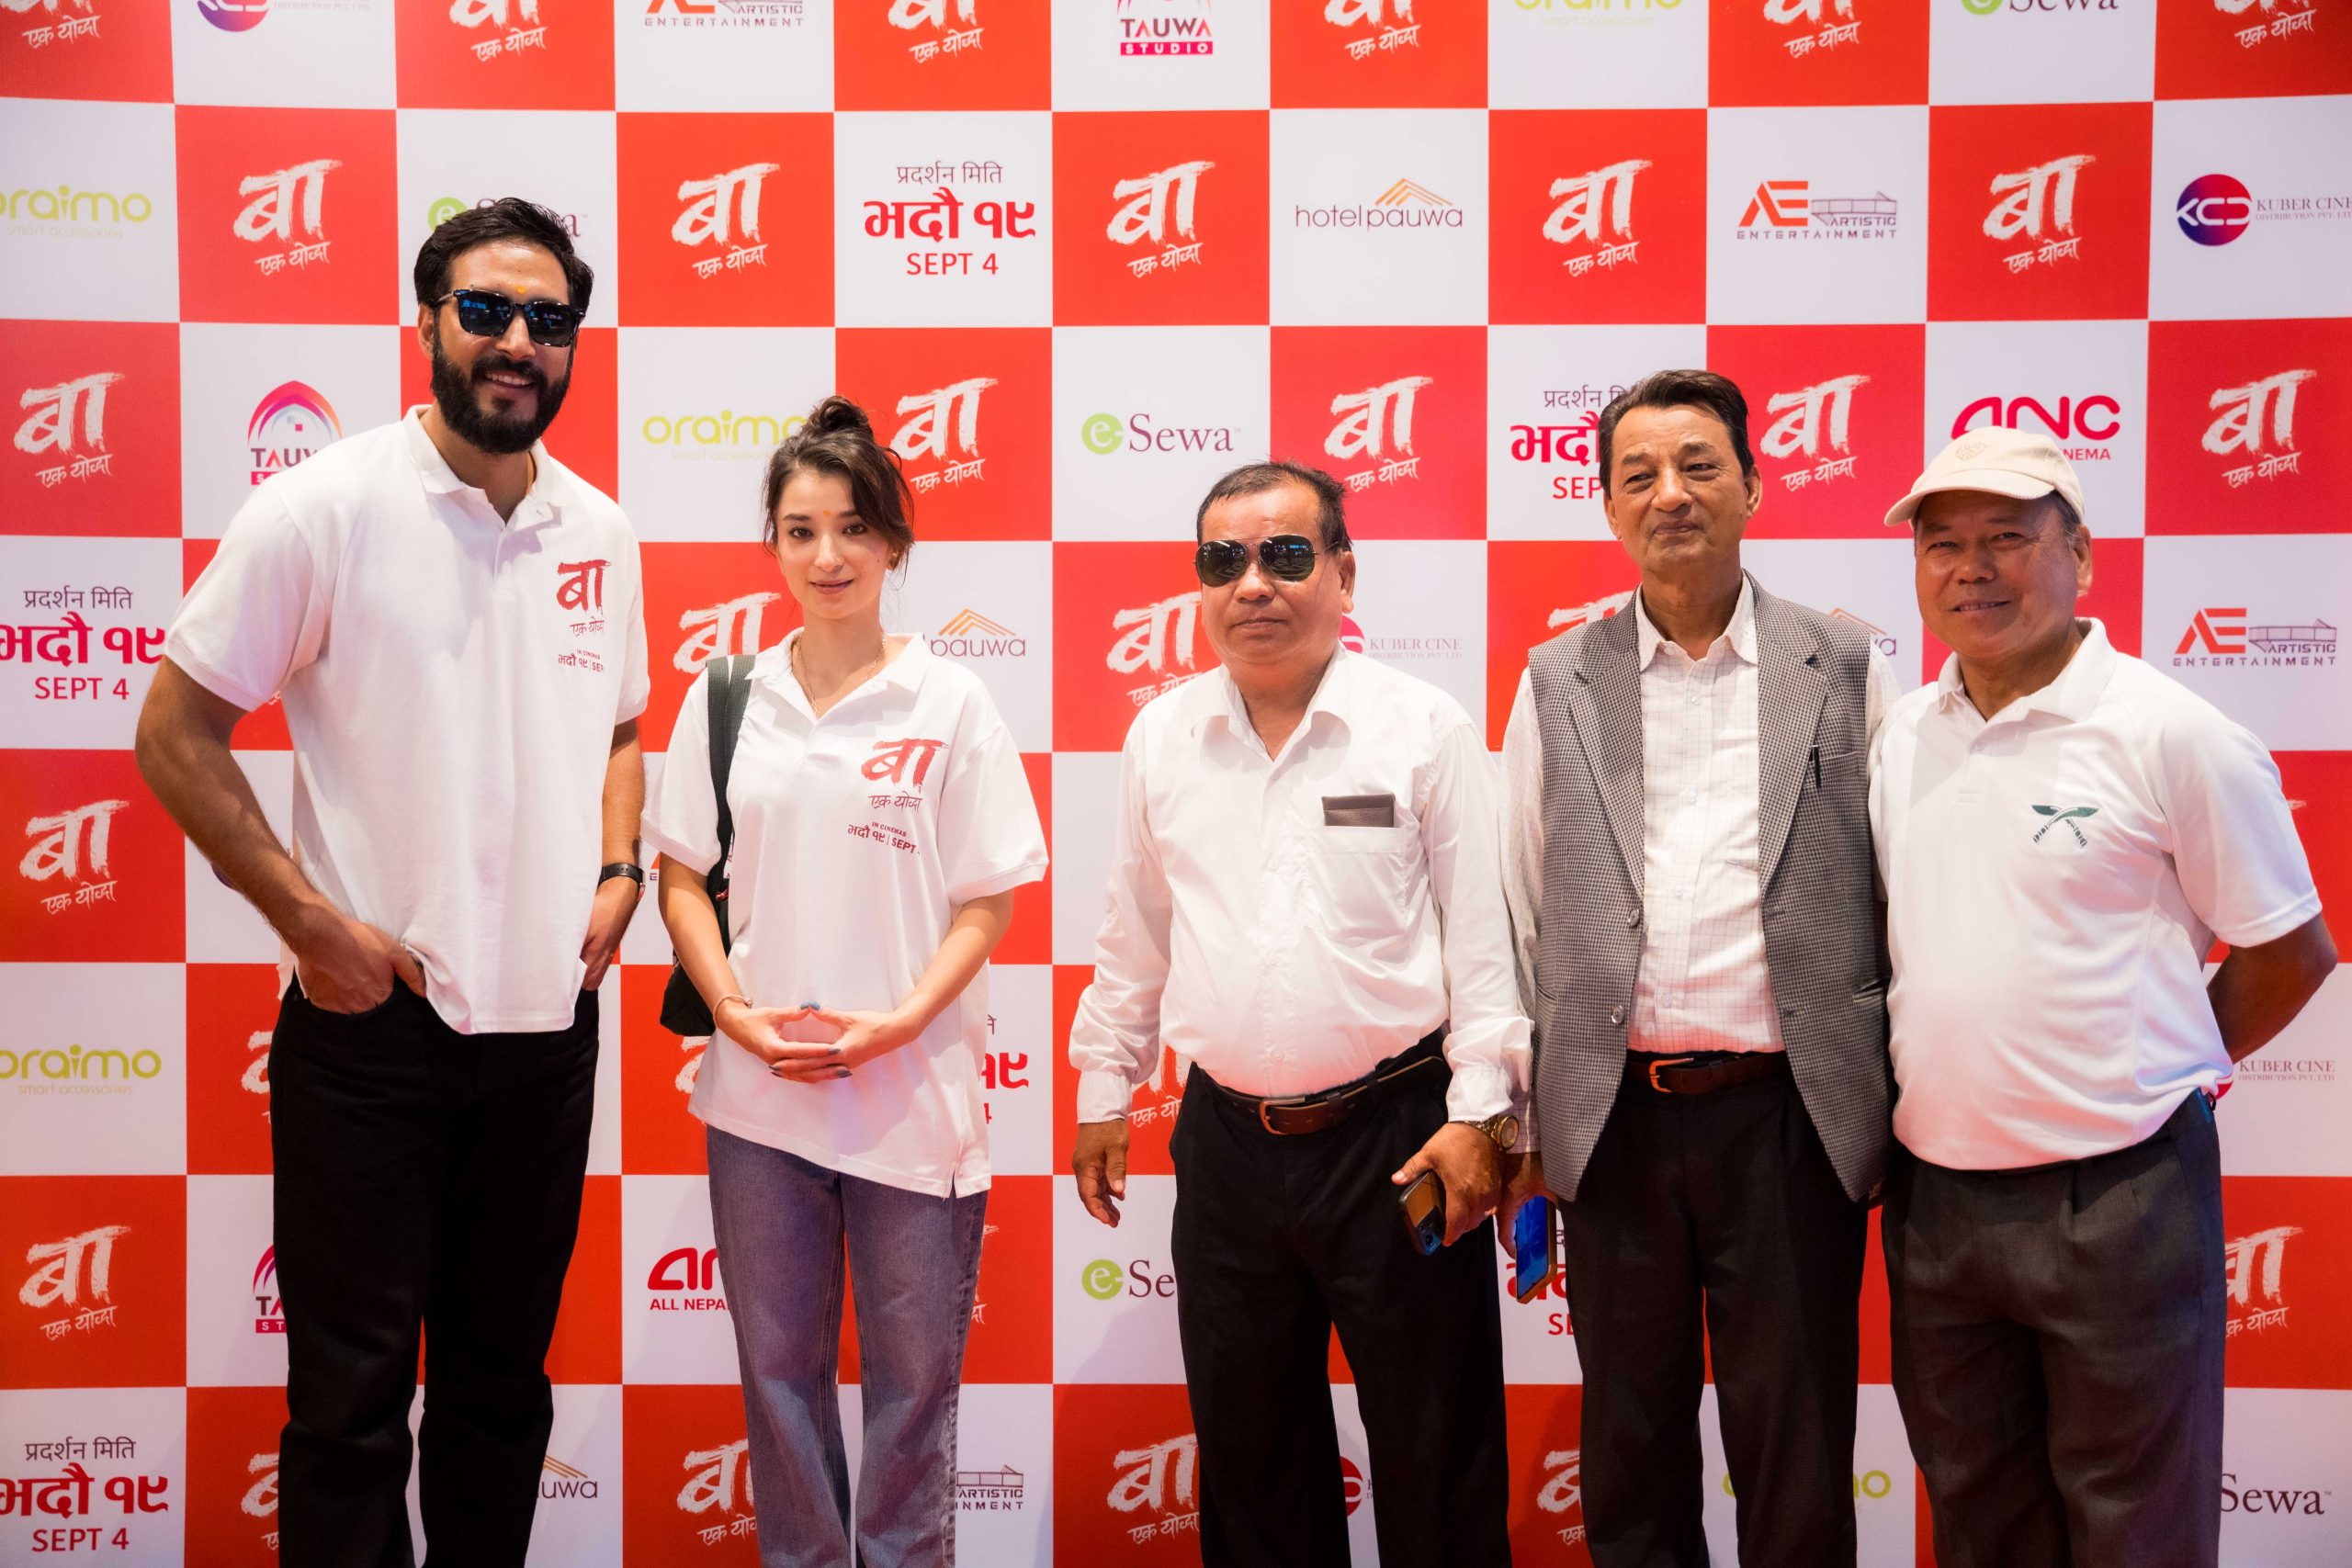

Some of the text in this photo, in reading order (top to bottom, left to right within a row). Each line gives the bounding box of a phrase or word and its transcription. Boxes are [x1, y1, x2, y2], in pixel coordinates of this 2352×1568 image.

[735, 6, 802, 14] ARTISTIC
[644, 17, 804, 27] ENTERTAINMENT
[1120, 18, 1212, 38] TAUWA
[22, 29, 54, 49] एक
[1783, 33, 1815, 59] एक
[2233, 24, 2267, 49] एक
[469, 42, 502, 62] एक
[909, 44, 940, 63] एक
[1125, 42, 1207, 55] STUDIO
[1345, 40, 1375, 61] एक
[897, 160, 1003, 186] प्रदर्शन मिति
[0, 185, 153, 222] raimo
[232, 159, 342, 243] बा
[672, 163, 781, 247] बा
[1106, 161, 1215, 244] बा
[1544, 160, 1653, 244] बा
[1983, 154, 2096, 241] बा
[2256, 198, 2312, 211] KUBER
[864, 187, 963, 243] भदौ
[1830, 217, 1896, 226] ARTISTIC
[1736, 230, 1897, 240] ENTERTAINMENT
[254, 255, 285, 276] एक
[692, 258, 723, 279] एक
[906, 254, 999, 276] SEPT 4
[1127, 258, 1158, 278] एक
[1564, 257, 1595, 277] एक
[2003, 254, 2034, 274] एक
[1543, 384, 1602, 409] प्रदर्शन
[14, 373, 124, 454] बा
[1324, 376, 1433, 460] बा
[1759, 375, 1871, 458] बा
[2201, 369, 2317, 457] बा
[2063, 448, 2110, 460] NEMA
[36, 468, 66, 488] एक
[910, 474, 941, 494] एक
[1345, 474, 1375, 493] एक
[1553, 477, 1602, 499] SEP
[1781, 469, 1812, 491] एक
[2222, 468, 2252, 488] एक
[24, 585, 133, 609] प्रदर्शन मिति
[557, 558, 611, 615] बा
[1425, 638, 1463, 650] CINE
[2267, 644, 2336, 654] ARTISTIC
[2173, 656, 2336, 667] ENTERTAINMENT
[35, 677, 130, 701] SEPT 4
[861, 738, 948, 794] बा
[20, 800, 130, 882] बा
[879, 824, 907, 838] CINEMAS
[891, 836, 917, 854] SEPT
[40, 895, 71, 915] एक
[2239, 1061, 2335, 1072] KUBER CINE
[19, 1225, 130, 1308] बा
[650, 1298, 727, 1311] ALL NEPA
[40, 1320, 71, 1340] एक
[25, 1437, 136, 1461] प्रदर्शन मिति
[958, 1489, 1023, 1498] ARTISTIC
[2221, 1473, 2324, 1515] Sewa
[32, 1528, 130, 1552] SEPT 4
[1127, 1523, 1158, 1544] एक
